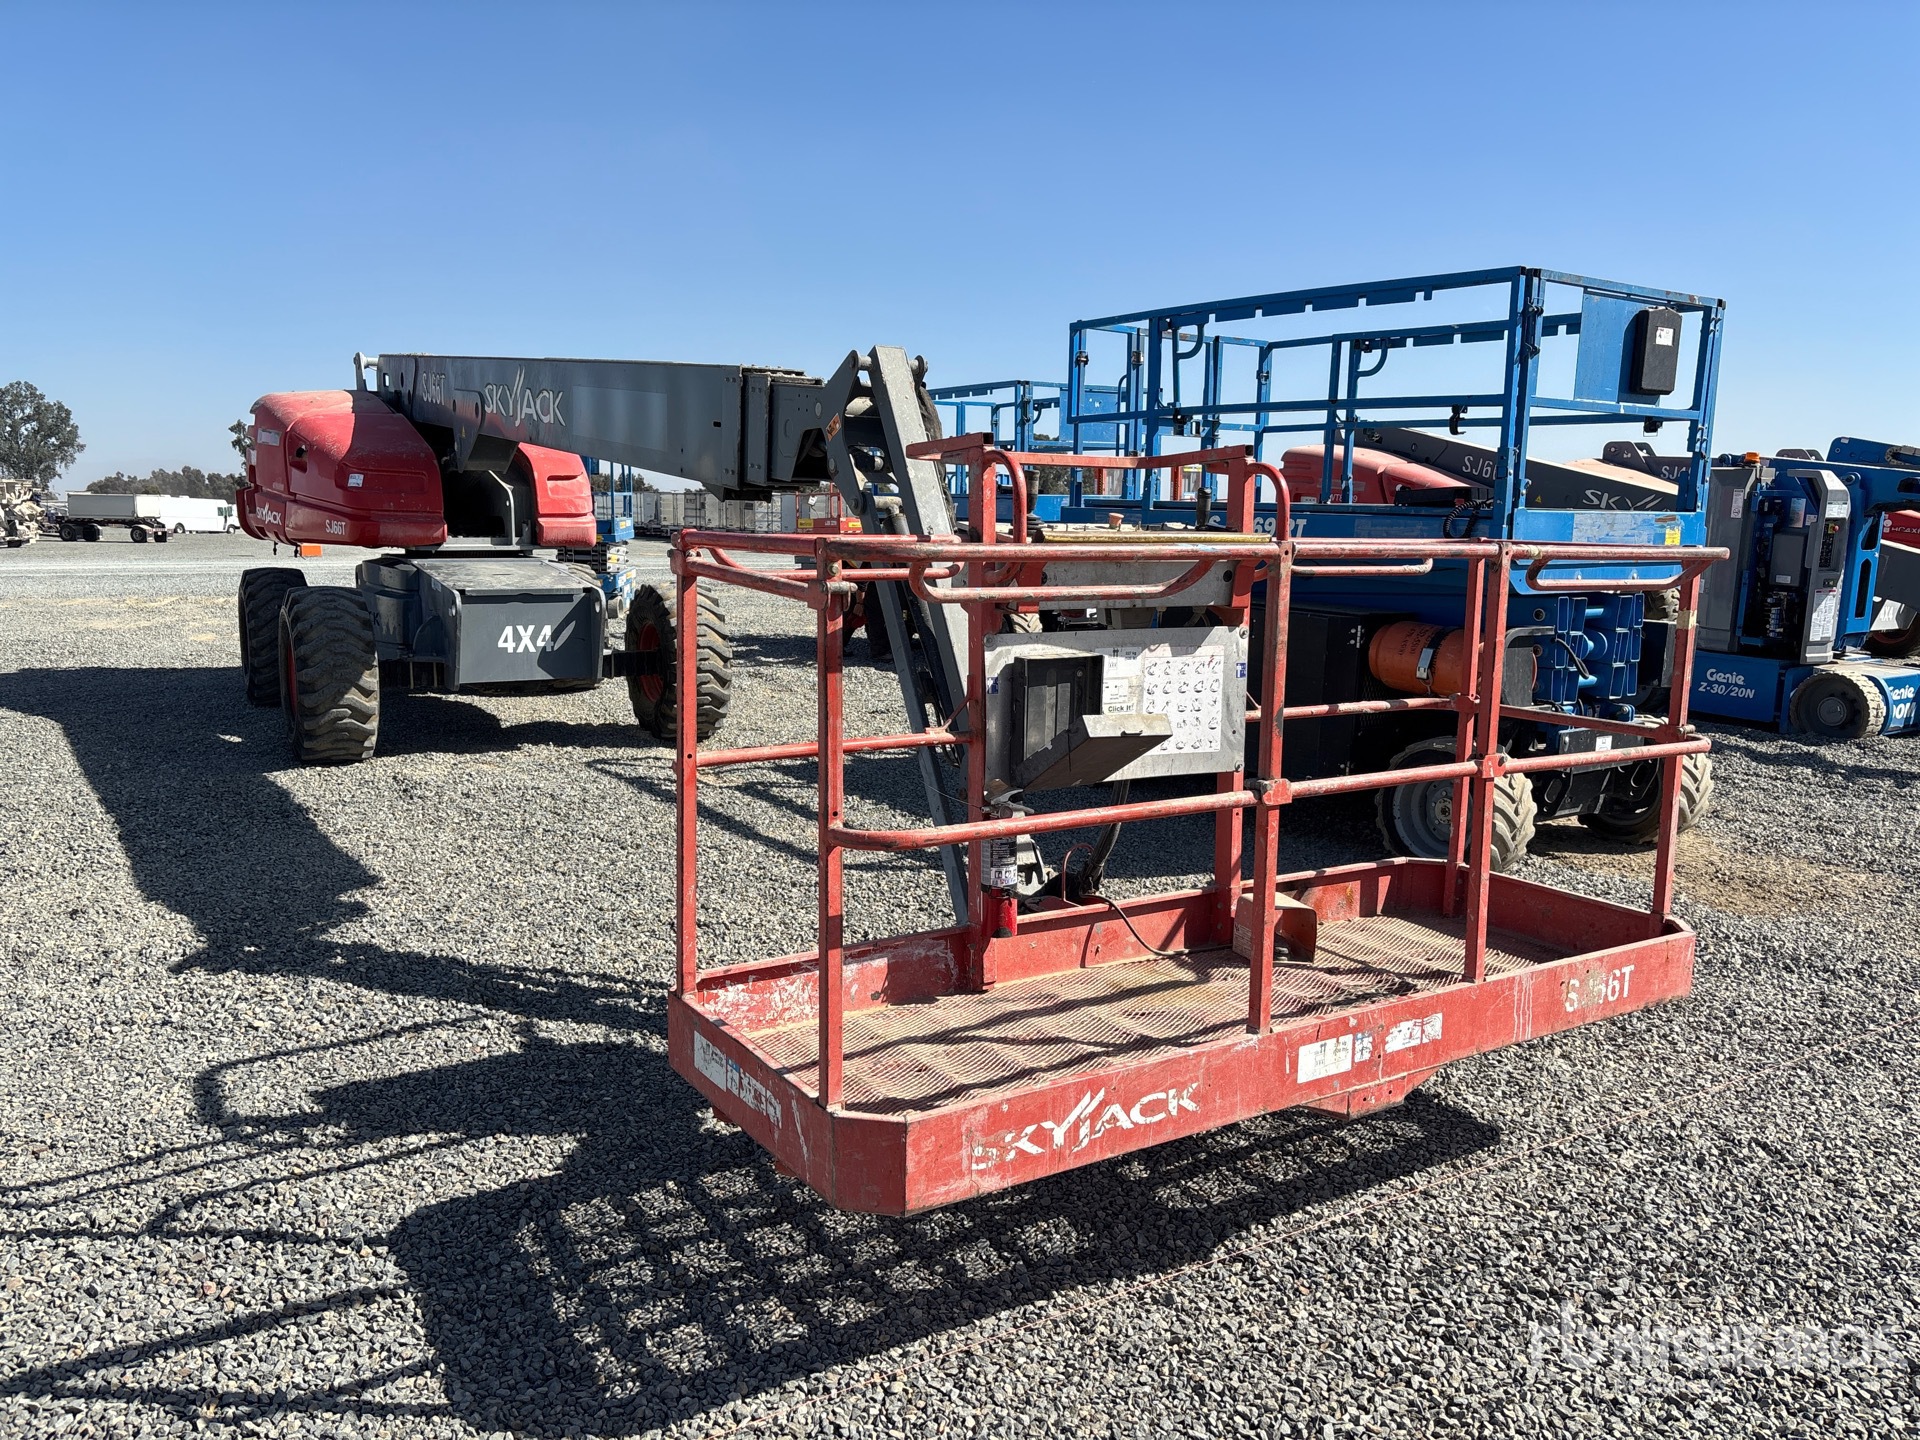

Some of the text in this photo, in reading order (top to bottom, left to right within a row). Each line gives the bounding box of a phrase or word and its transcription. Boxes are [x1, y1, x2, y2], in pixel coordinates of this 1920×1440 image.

[422, 372, 446, 406] SJ66T
[484, 364, 566, 427] SKYJACK
[1462, 455, 1497, 480] SJ6
[256, 502, 282, 526] SKYJACK
[325, 519, 346, 536] SJ66T
[498, 624, 554, 653] 4X4
[1706, 668, 1745, 685] Genie
[1698, 682, 1755, 699] Z-30/20N
[1108, 705, 1124, 713] Click
[1564, 965, 1635, 1012] S66T
[971, 1082, 1200, 1170] SKYJACK
